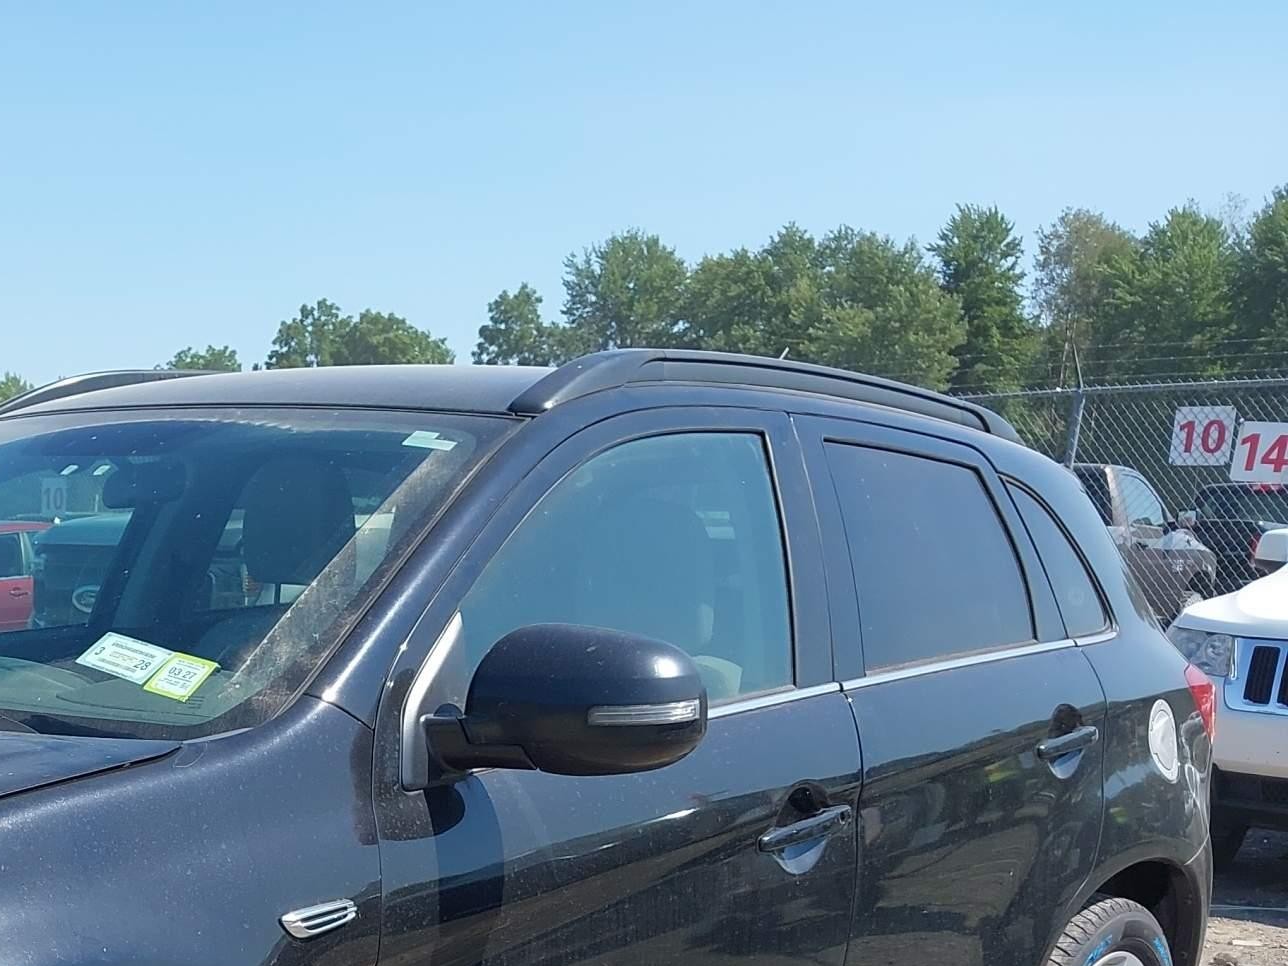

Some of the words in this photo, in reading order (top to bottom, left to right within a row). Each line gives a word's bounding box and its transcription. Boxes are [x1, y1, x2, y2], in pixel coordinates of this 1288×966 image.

[1179, 419, 1226, 454] 10
[1240, 432, 1288, 473] 14
[44, 487, 64, 510] 10
[94, 646, 106, 656] 3
[168, 666, 182, 676] 03
[182, 671, 198, 680] 27
